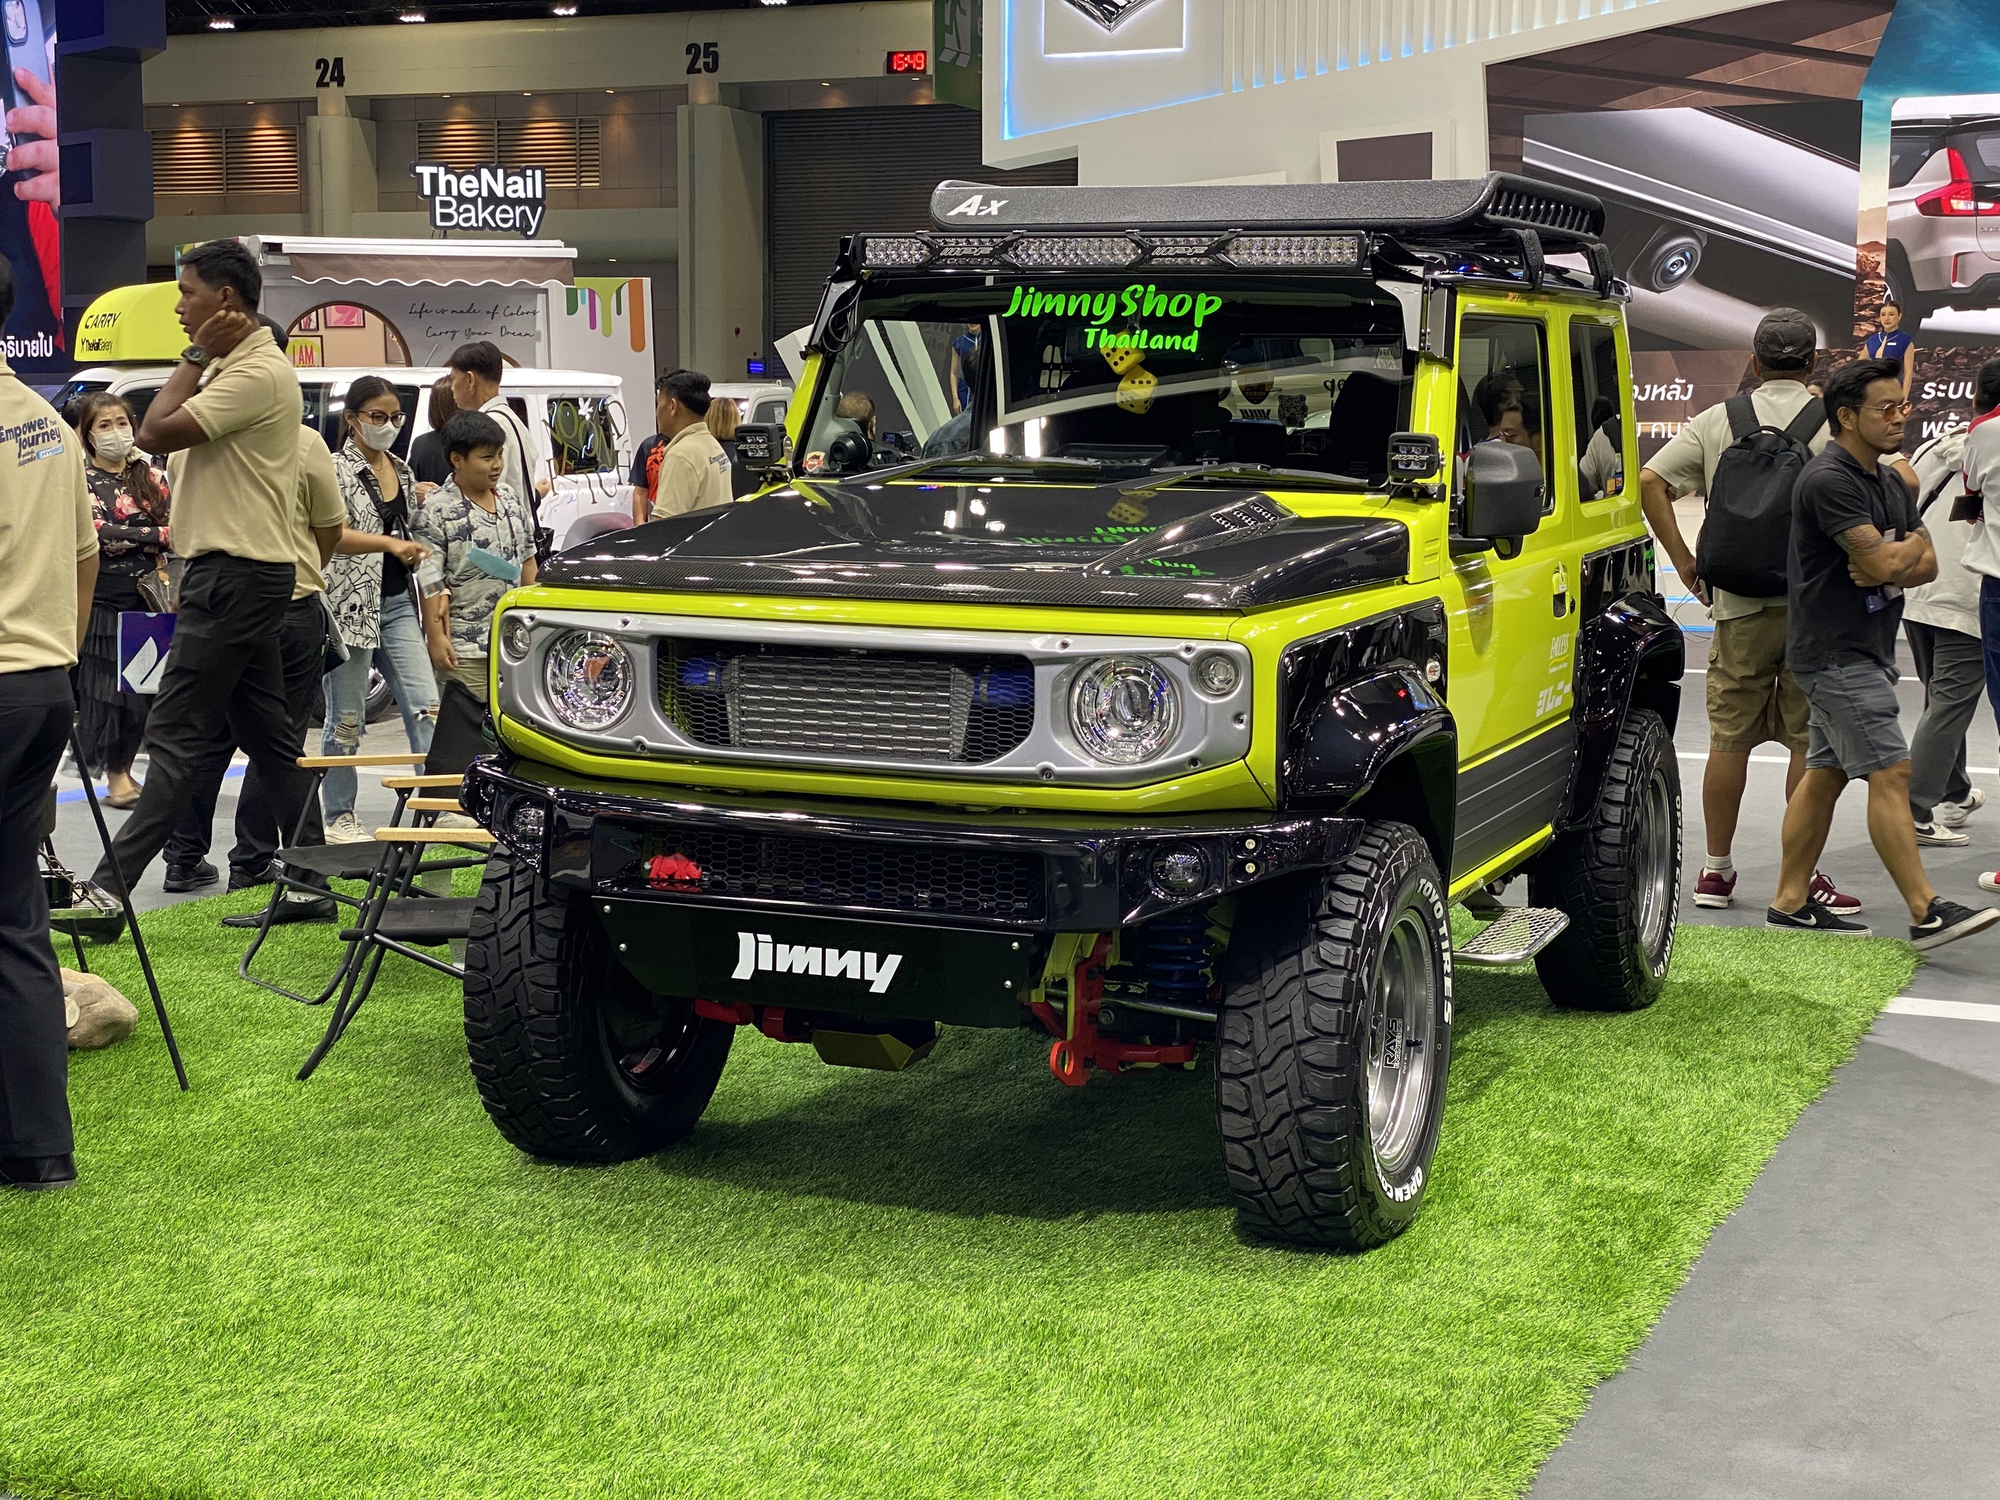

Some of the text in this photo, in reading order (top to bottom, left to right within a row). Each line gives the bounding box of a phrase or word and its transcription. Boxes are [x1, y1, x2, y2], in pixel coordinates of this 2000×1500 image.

[315, 57, 345, 87] 24
[684, 42, 719, 74] 25
[892, 52, 925, 72] 15:49
[415, 166, 543, 199] TheNail
[434, 196, 542, 235] Bakery
[84, 312, 122, 329] CARRY
[409, 303, 540, 320] Life is made of Colors
[425, 325, 535, 340] Carry Your Dream
[299, 344, 315, 365] AM
[0, 416, 48, 444] Empower
[731, 932, 903, 993] Jimny
[1417, 878, 1452, 1026] TOYO TIRES
[1383, 1018, 1397, 1068] RAYS
[1393, 1165, 1423, 1203] OPEN
